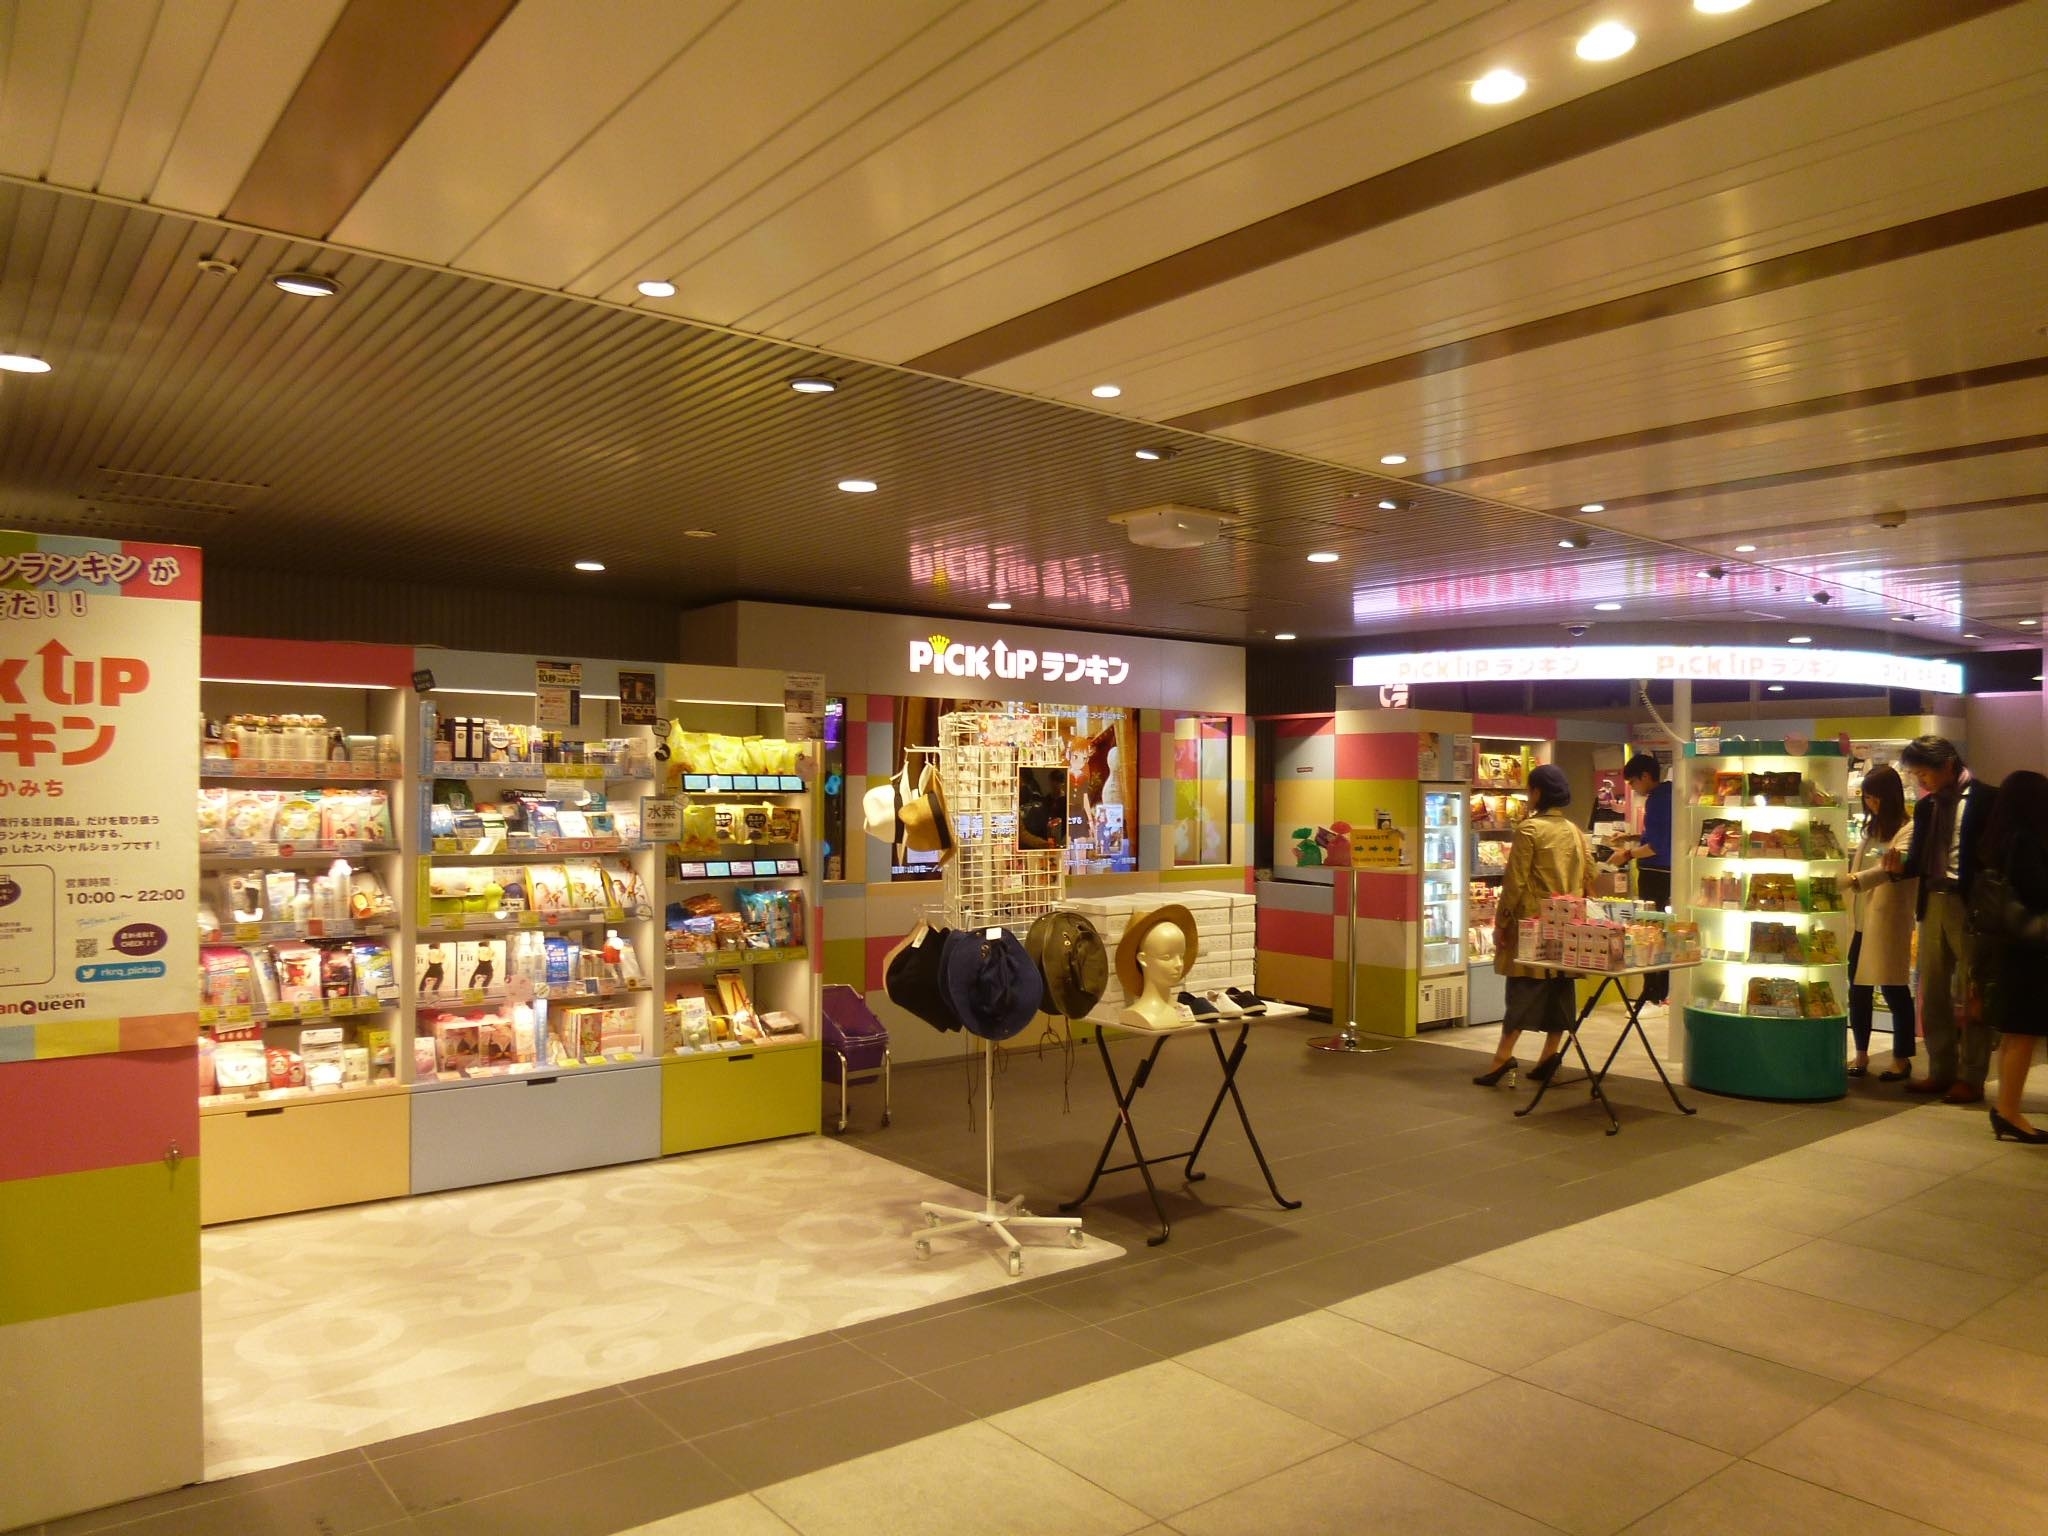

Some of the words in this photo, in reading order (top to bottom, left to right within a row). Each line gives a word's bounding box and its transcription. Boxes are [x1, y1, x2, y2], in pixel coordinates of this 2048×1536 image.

[0, 592, 86, 617] た！！
[992, 639, 1038, 680] UP
[1041, 651, 1129, 685] ランキン
[647, 804, 677, 819] 水素
[66, 891, 116, 905] 10:00
[137, 888, 185, 902] 22:00
